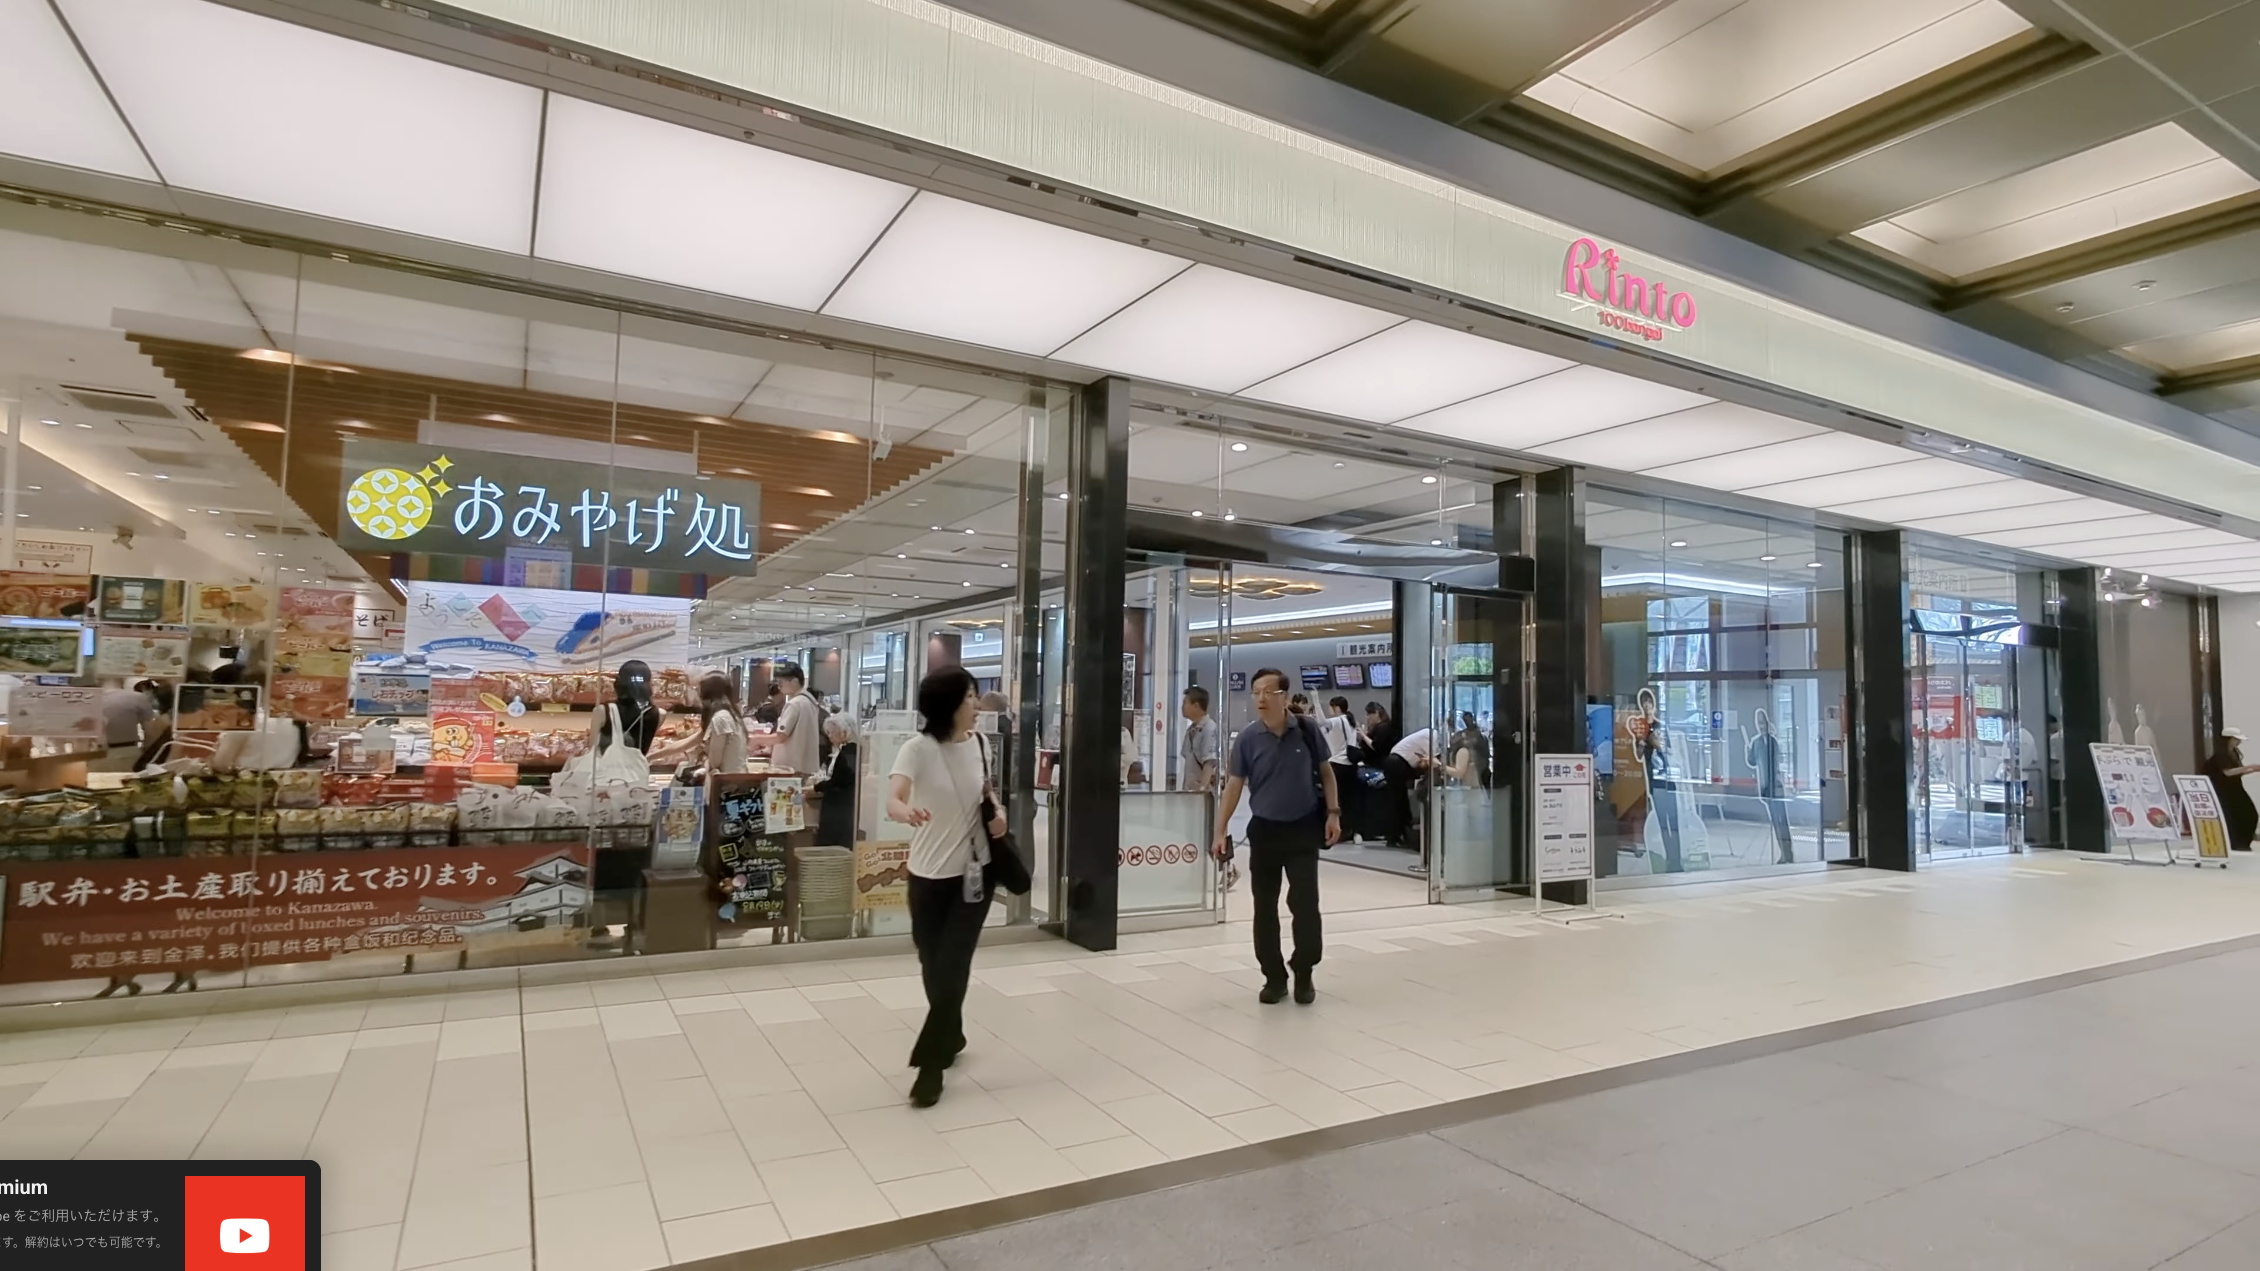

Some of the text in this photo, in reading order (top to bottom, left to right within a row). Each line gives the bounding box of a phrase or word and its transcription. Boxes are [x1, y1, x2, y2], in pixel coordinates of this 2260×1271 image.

[1566, 238, 1697, 328] Rinto
[453, 475, 753, 560] おみやげ処
[356, 614, 389, 627] そば
[430, 638, 530, 655] Welcome To KANAZAWA
[1350, 643, 1393, 655] 観光案内所
[1543, 764, 1571, 777] 営業中
[18, 862, 498, 908] 駅弁・お土産取り揃えております。
[176, 900, 378, 921] Welcome to Kanazawa.
[41, 932, 74, 946] We
[79, 930, 127, 945] have
[132, 930, 143, 941] a
[148, 924, 213, 940] variety
[217, 921, 237, 935] of
[299, 916, 365, 930] lunches
[369, 911, 400, 925] and
[404, 908, 485, 925] souvenirs.
